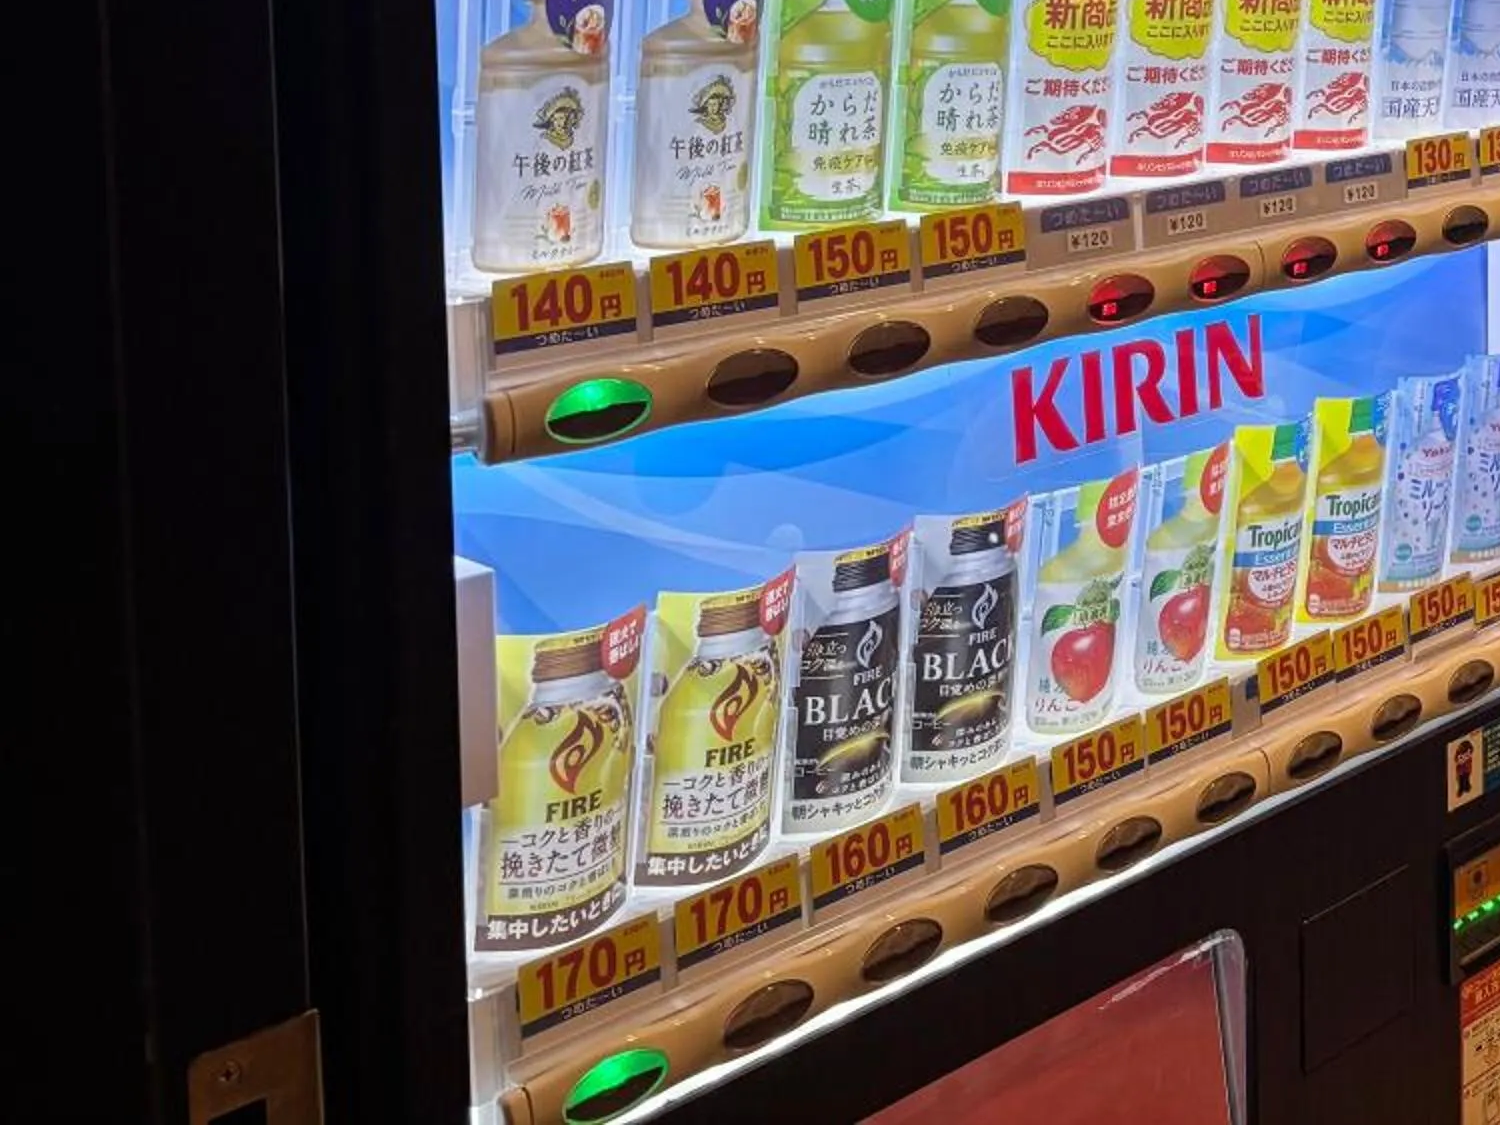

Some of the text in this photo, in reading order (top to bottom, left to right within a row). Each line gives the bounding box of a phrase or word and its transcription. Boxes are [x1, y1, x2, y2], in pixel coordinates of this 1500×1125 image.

[670, 132, 744, 161] 午後の紅茶
[512, 147, 594, 178] 午後の紅茶
[1346, 185, 1376, 201] ¥120
[1263, 198, 1294, 215] ¥120
[1169, 214, 1204, 231] ¥120
[1071, 230, 1110, 248] ¥120
[1011, 313, 1265, 465] KIRIN
[969, 628, 997, 647] FIRE
[854, 664, 882, 686] FIRE
[805, 673, 897, 726] BLAC
[705, 738, 755, 767] FIRE
[546, 789, 602, 824] FIRE
